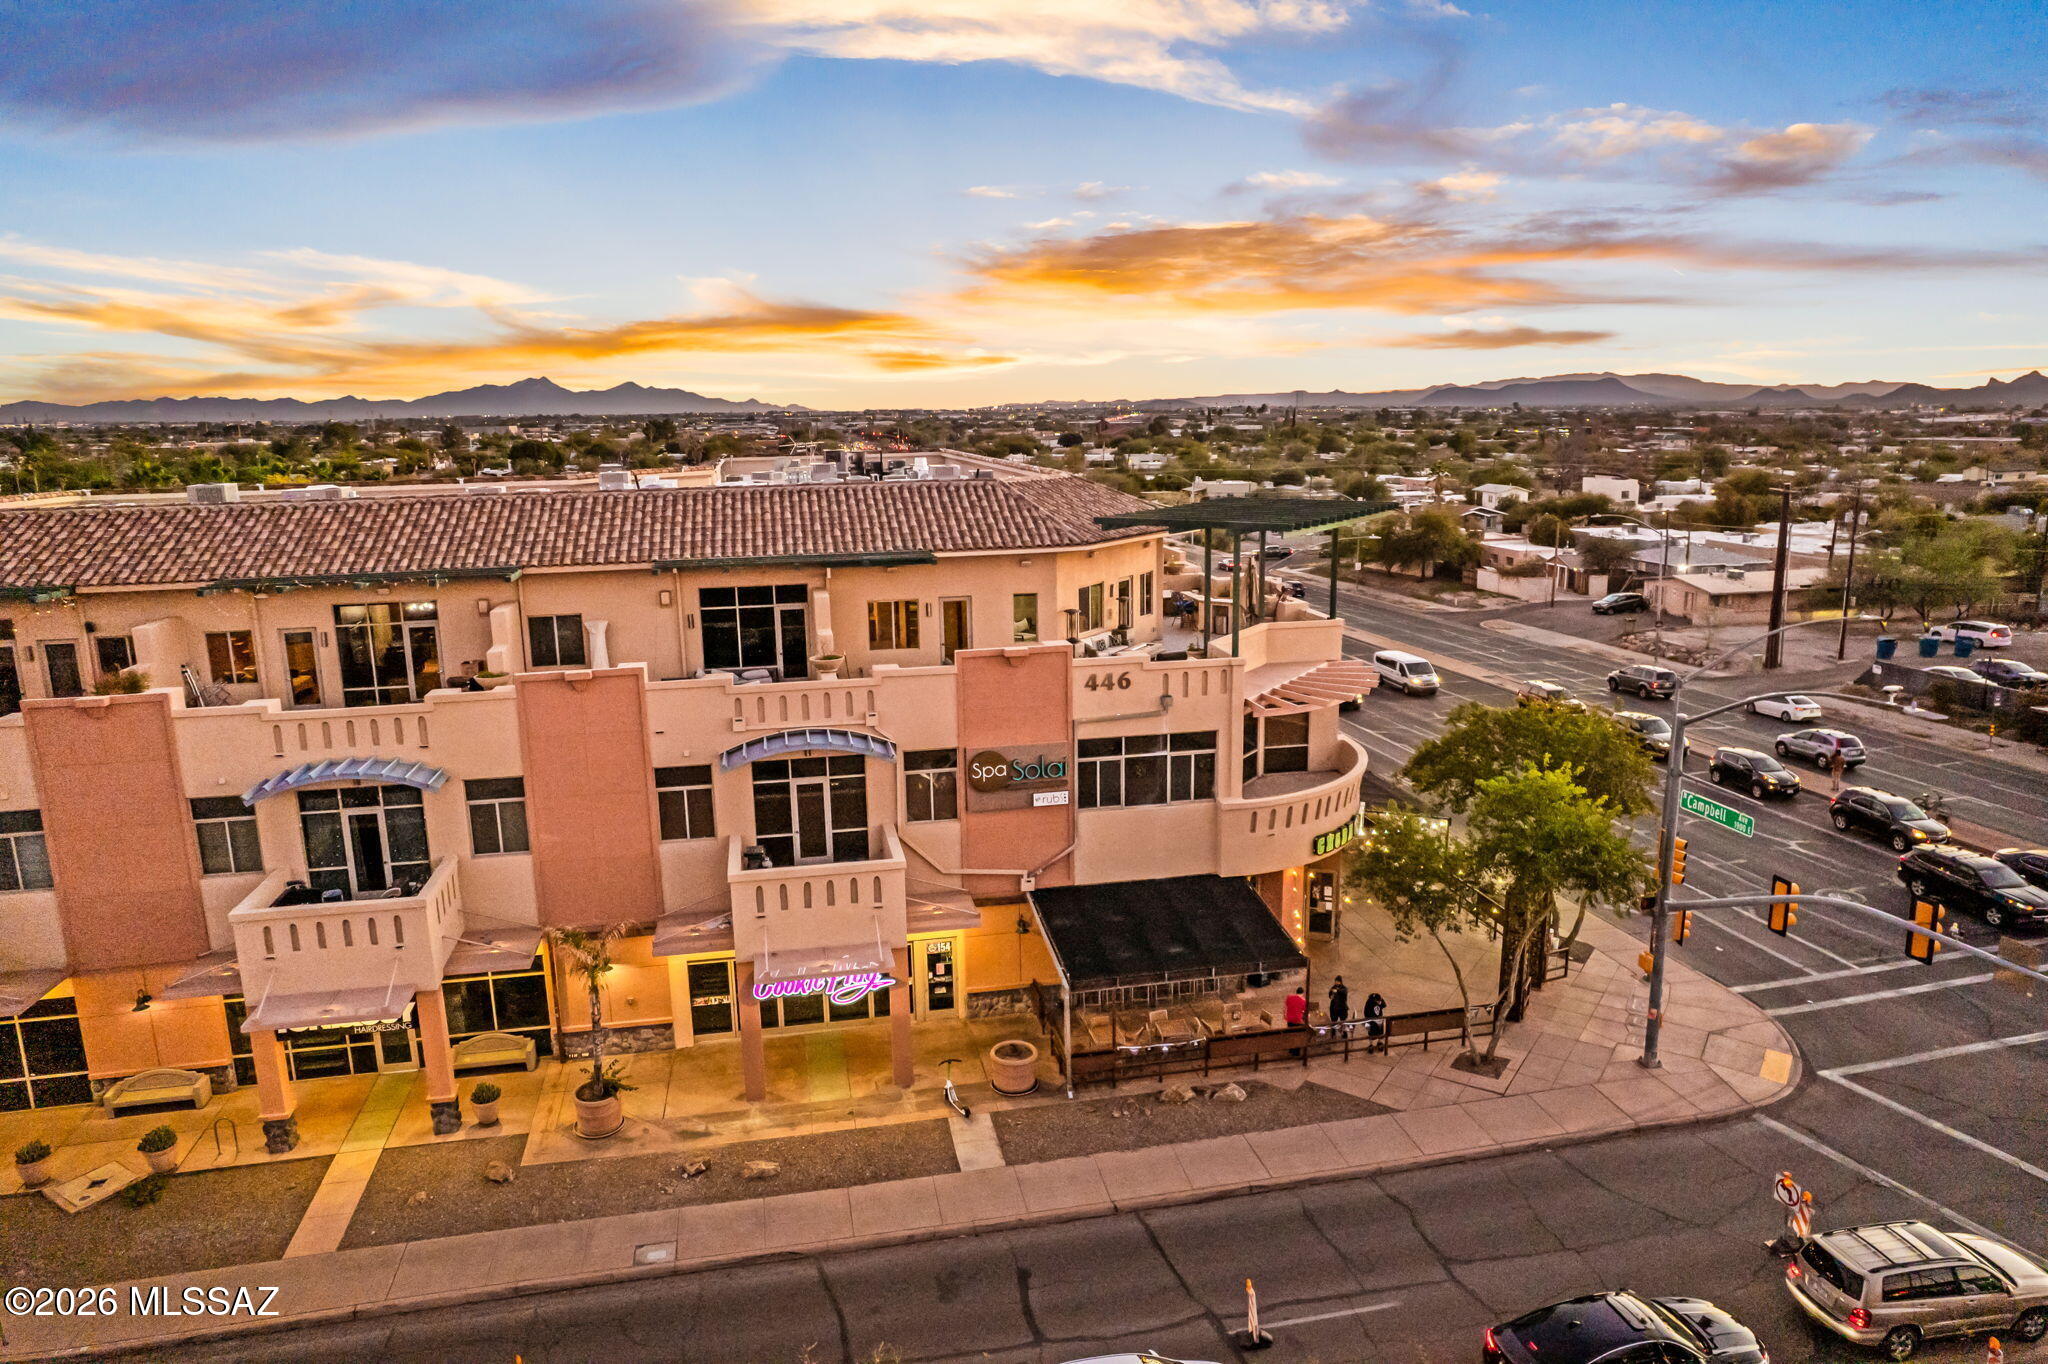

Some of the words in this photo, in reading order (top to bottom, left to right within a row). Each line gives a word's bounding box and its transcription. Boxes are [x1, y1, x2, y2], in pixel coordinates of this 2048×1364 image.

[1084, 671, 1131, 691] 446
[971, 763, 1007, 782] Spa
[1687, 794, 1727, 822] Campbell
[1738, 813, 1748, 825] Ave
[937, 942, 951, 952] 154
[354, 1022, 412, 1034] HAIRDRESSING
